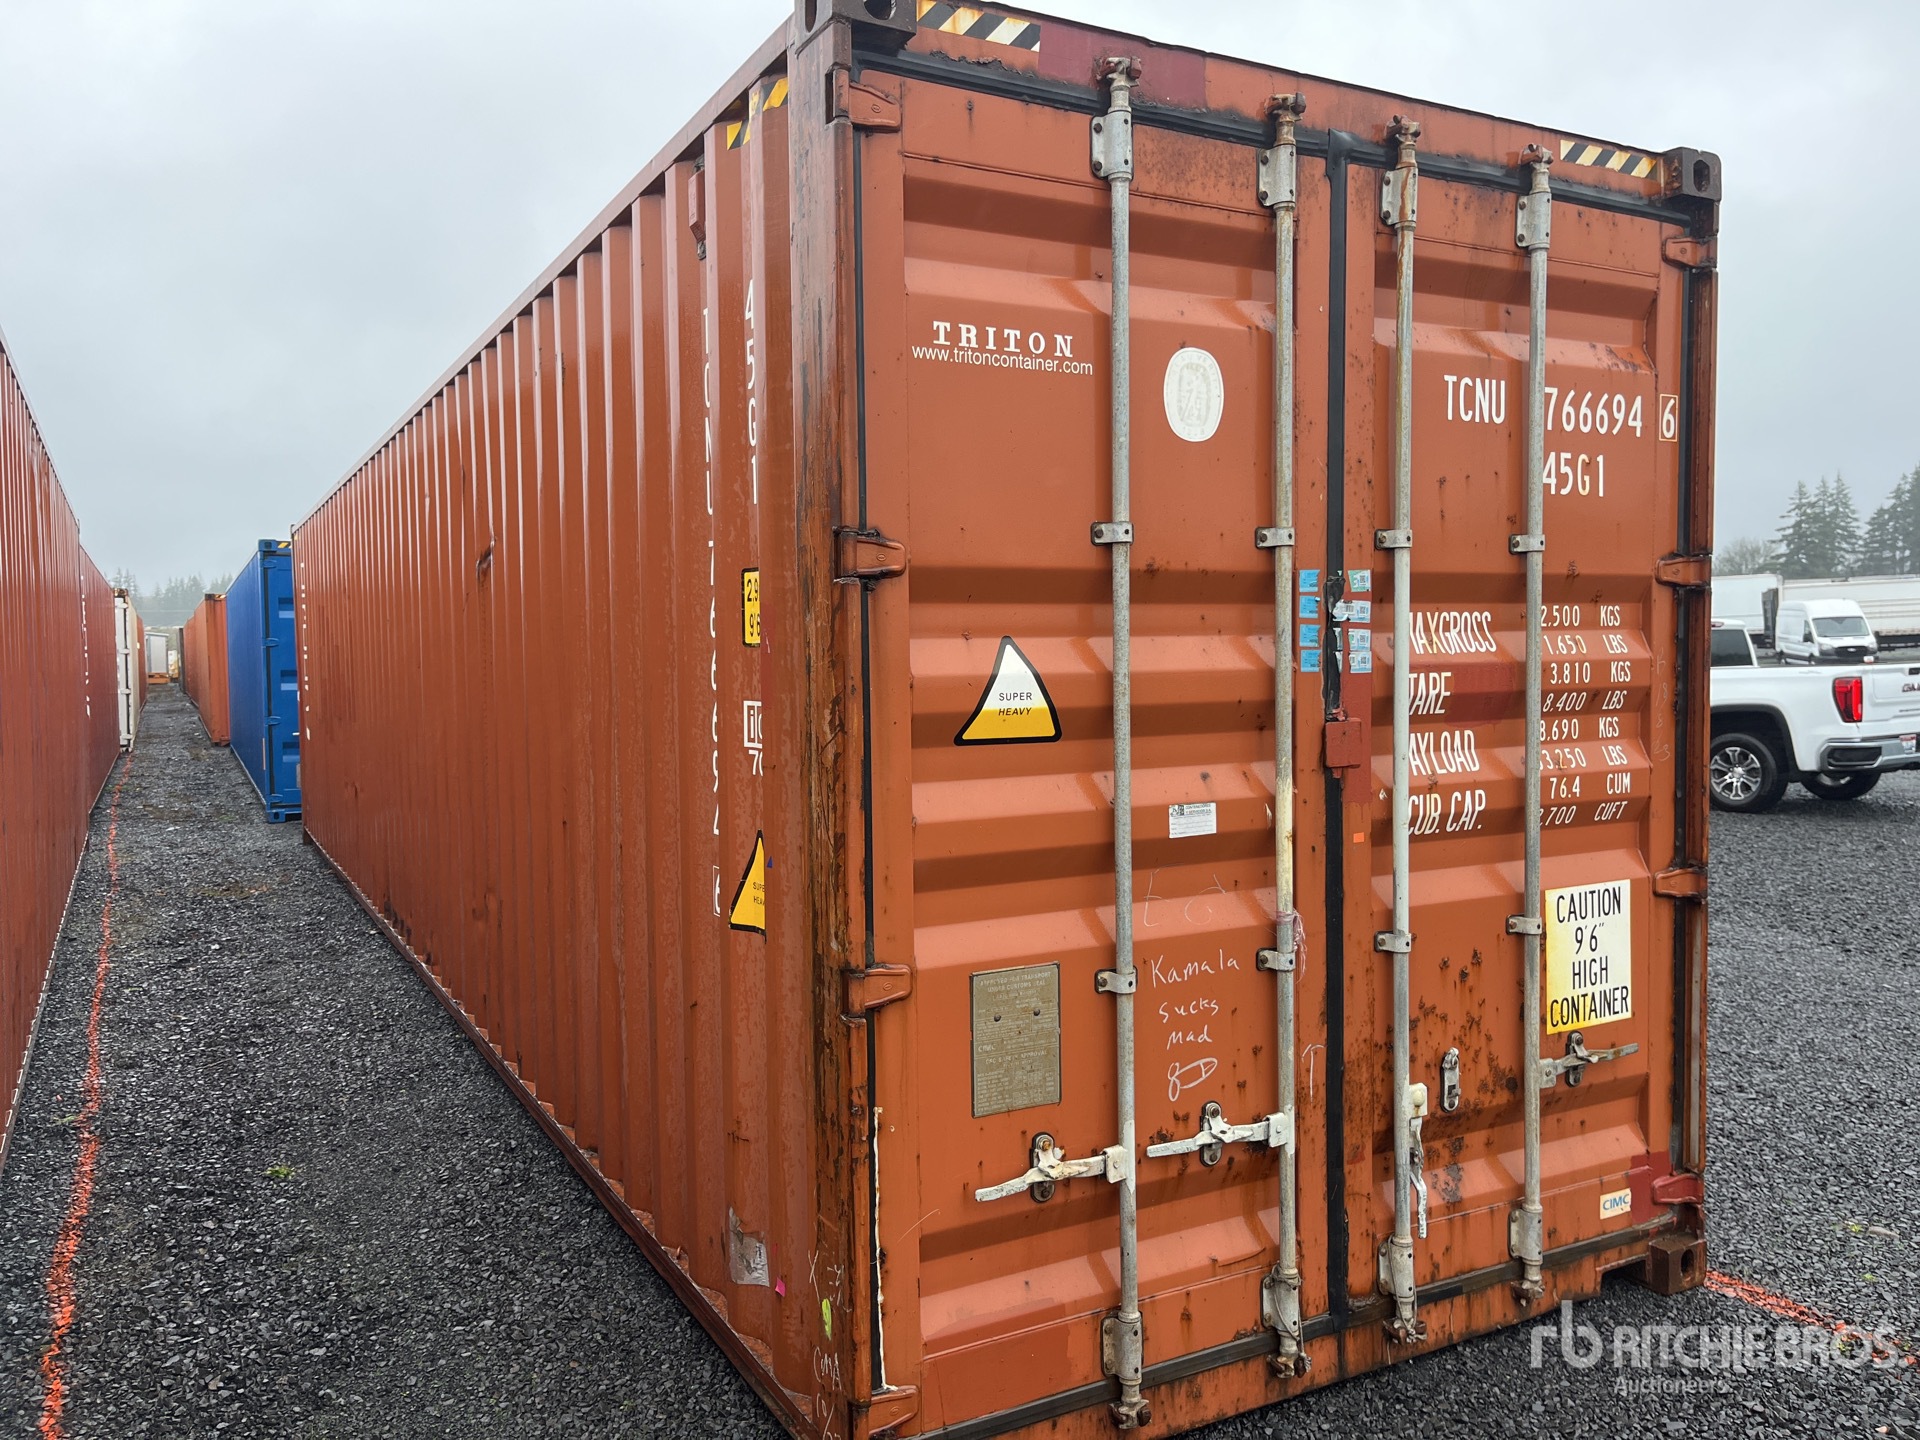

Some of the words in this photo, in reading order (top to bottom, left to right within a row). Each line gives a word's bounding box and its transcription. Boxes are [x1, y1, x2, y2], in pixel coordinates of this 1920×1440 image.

[933, 321, 1073, 358] TRITON
[911, 344, 1094, 376] www.tritoncontainer.com
[1443, 374, 1506, 425] TCNU
[1544, 386, 1643, 438] 766694
[1661, 397, 1677, 440] 6
[1542, 450, 1605, 498] 45G1
[1600, 605, 1621, 627] KGS
[1602, 634, 1628, 654] LBS
[998, 692, 1033, 702] SUPER
[1408, 671, 1452, 716] TARE
[1550, 662, 1591, 685] 3,810
[1610, 661, 1632, 683] KGS
[1601, 690, 1628, 710] LBS
[998, 707, 1032, 716] HEAVY
[1408, 729, 1480, 777] AYLOAD
[1599, 717, 1620, 739] KGS
[1601, 745, 1628, 767] LBS
[1408, 792, 1442, 836] CUB.
[1446, 789, 1487, 833] CAP.
[1549, 775, 1581, 800] 76.4
[1606, 772, 1631, 795] CUM
[1594, 800, 1628, 822] CUFT
[1556, 886, 1621, 924] CAUTION
[1150, 948, 1240, 989] Kamala
[1572, 955, 1609, 990] HIGH
[1550, 985, 1629, 1028] CONTAINER
[1602, 1193, 1630, 1211] CIMC
